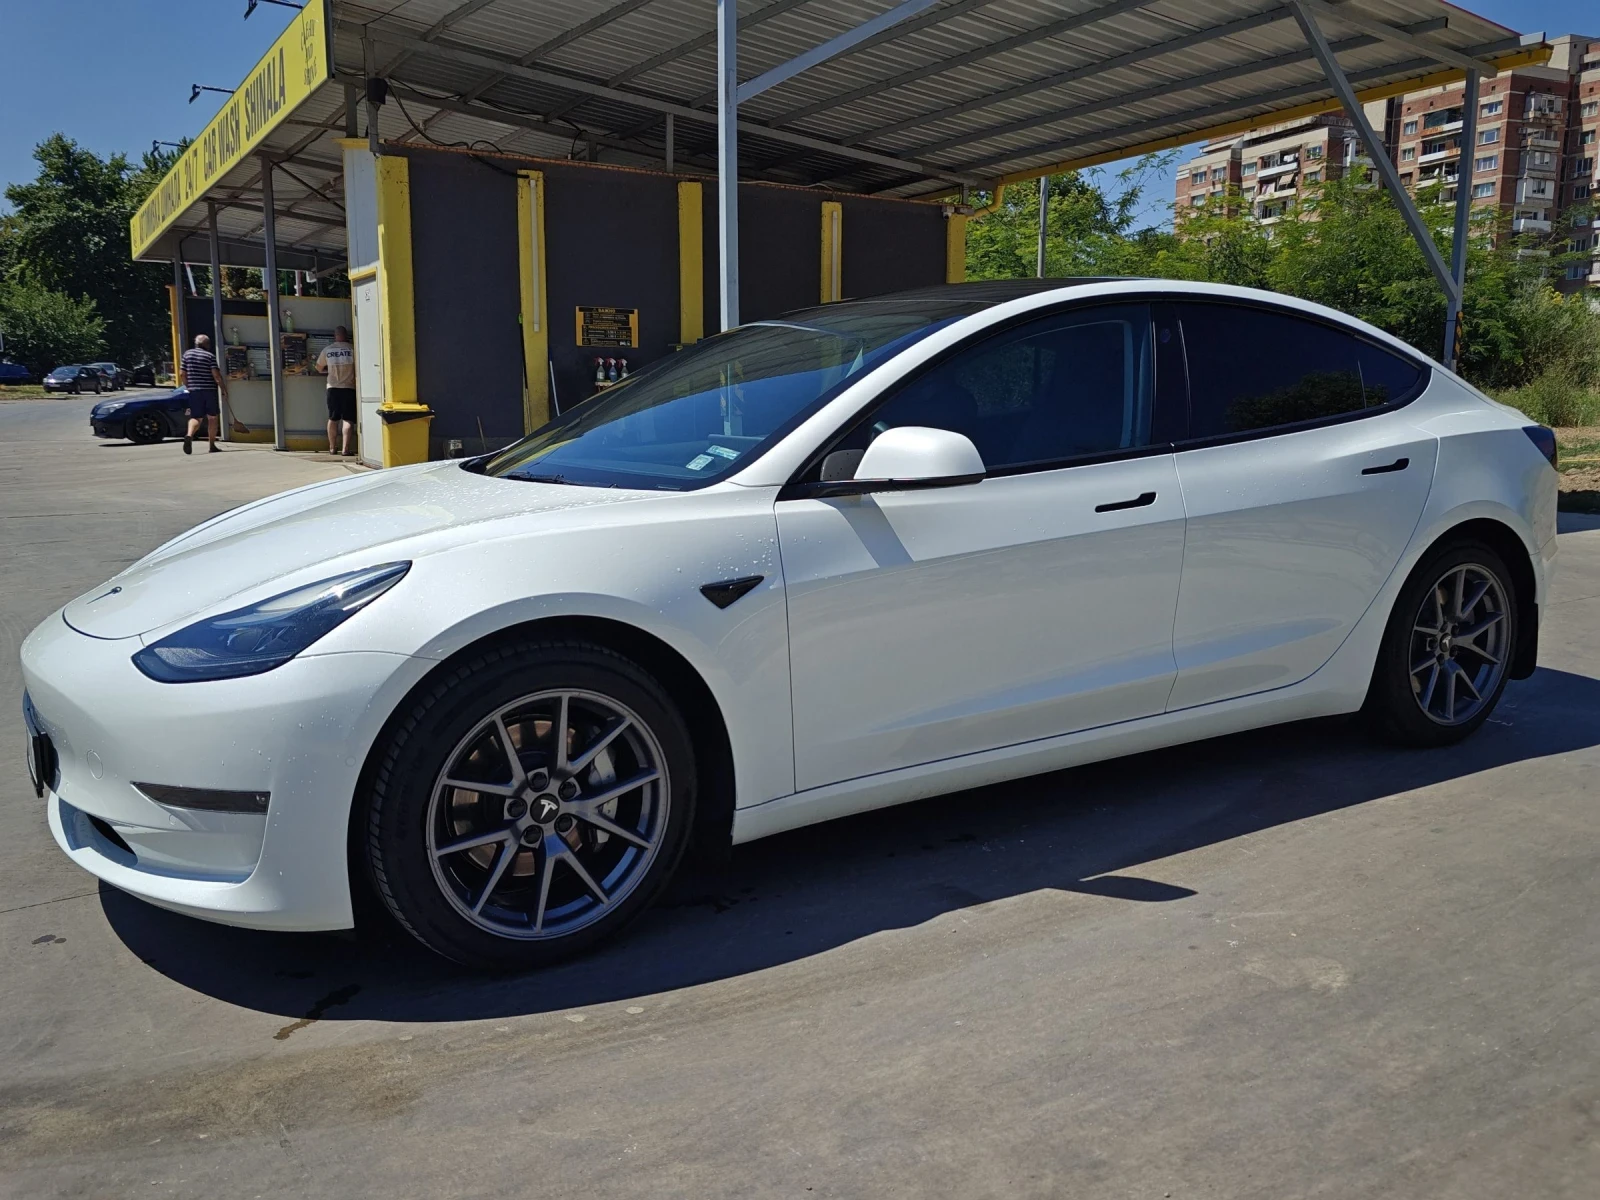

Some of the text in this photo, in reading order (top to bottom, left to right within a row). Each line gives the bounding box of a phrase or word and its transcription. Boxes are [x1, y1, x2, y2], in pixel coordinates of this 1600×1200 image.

[203, 127, 217, 182] CAR
[217, 98, 241, 167] WASH
[244, 46, 286, 142] SHINALA
[326, 350, 351, 358] CREATE
